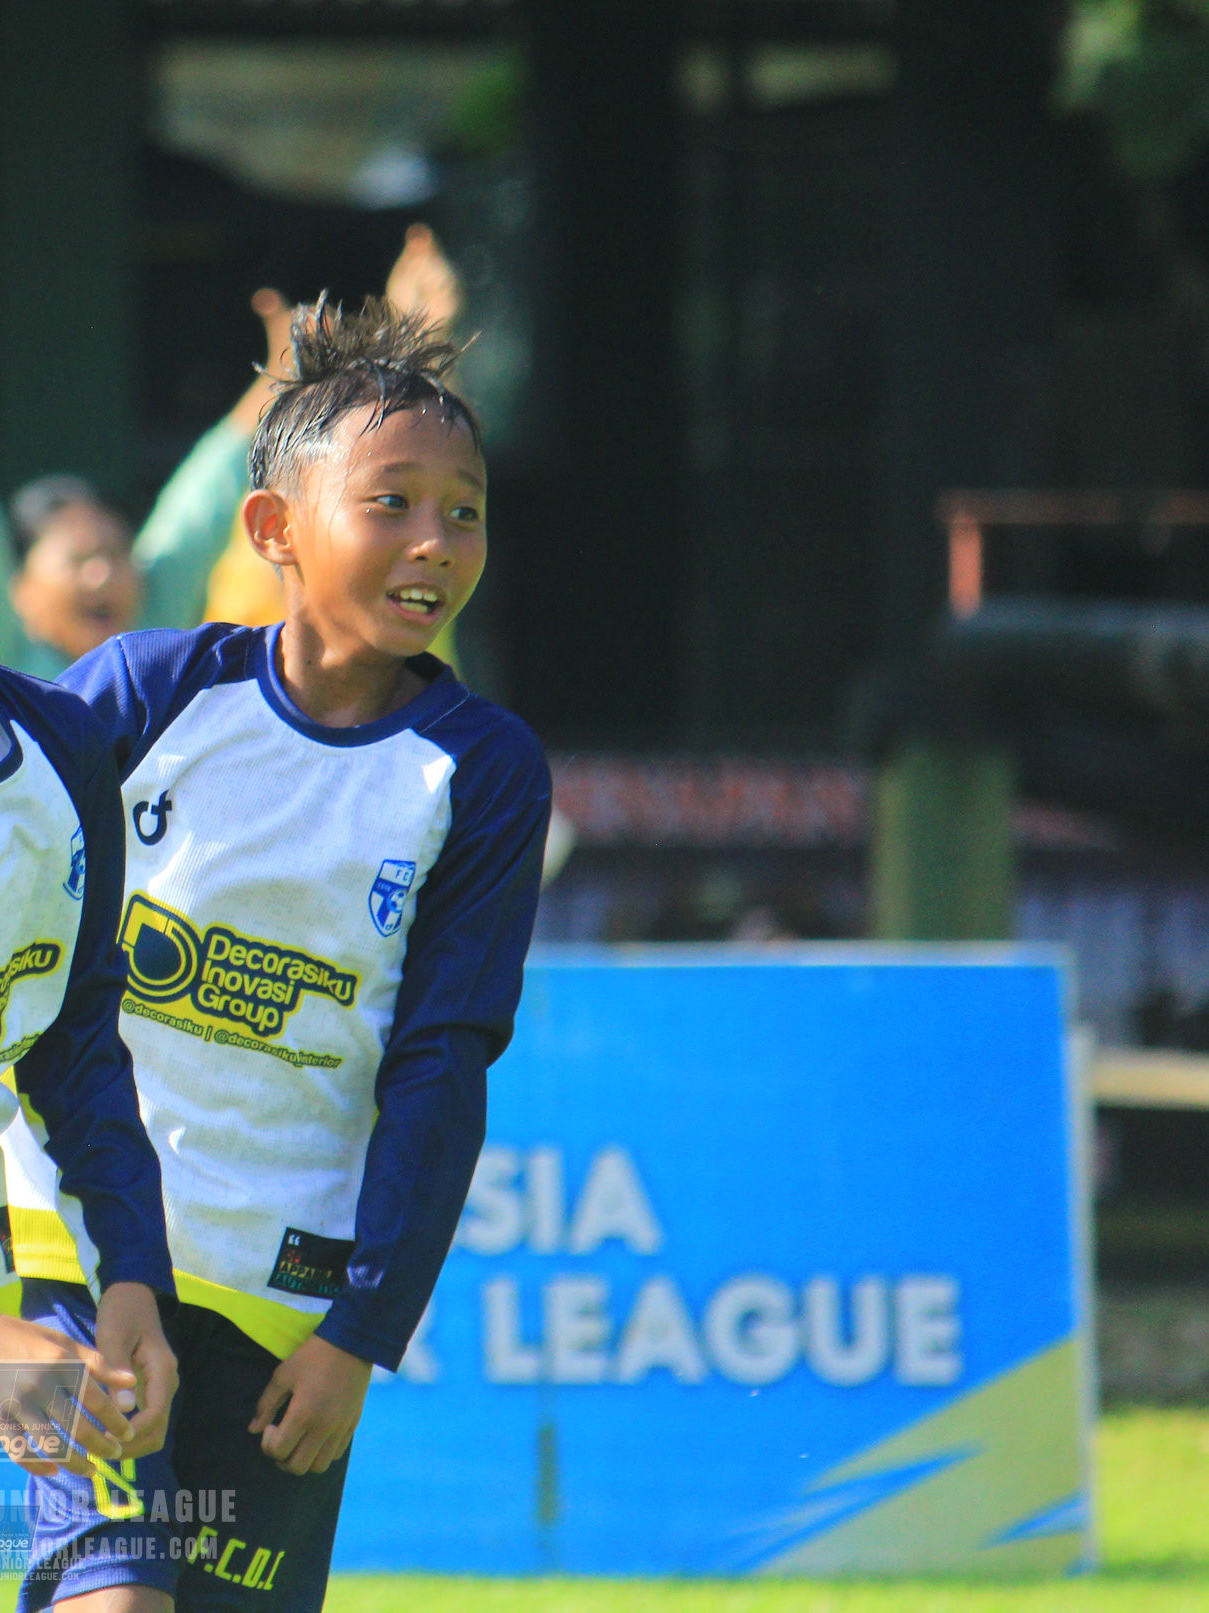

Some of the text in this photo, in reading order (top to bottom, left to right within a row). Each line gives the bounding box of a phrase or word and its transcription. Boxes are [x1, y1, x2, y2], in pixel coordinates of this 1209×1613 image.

[201, 960, 296, 1005] Inovasi
[206, 934, 351, 1001] Decorasiku
[120, 997, 204, 1037] @decorasiku
[197, 982, 280, 1032] Group
[450, 1145, 664, 1255] SIA
[482, 1274, 963, 1386] LEAGUE
